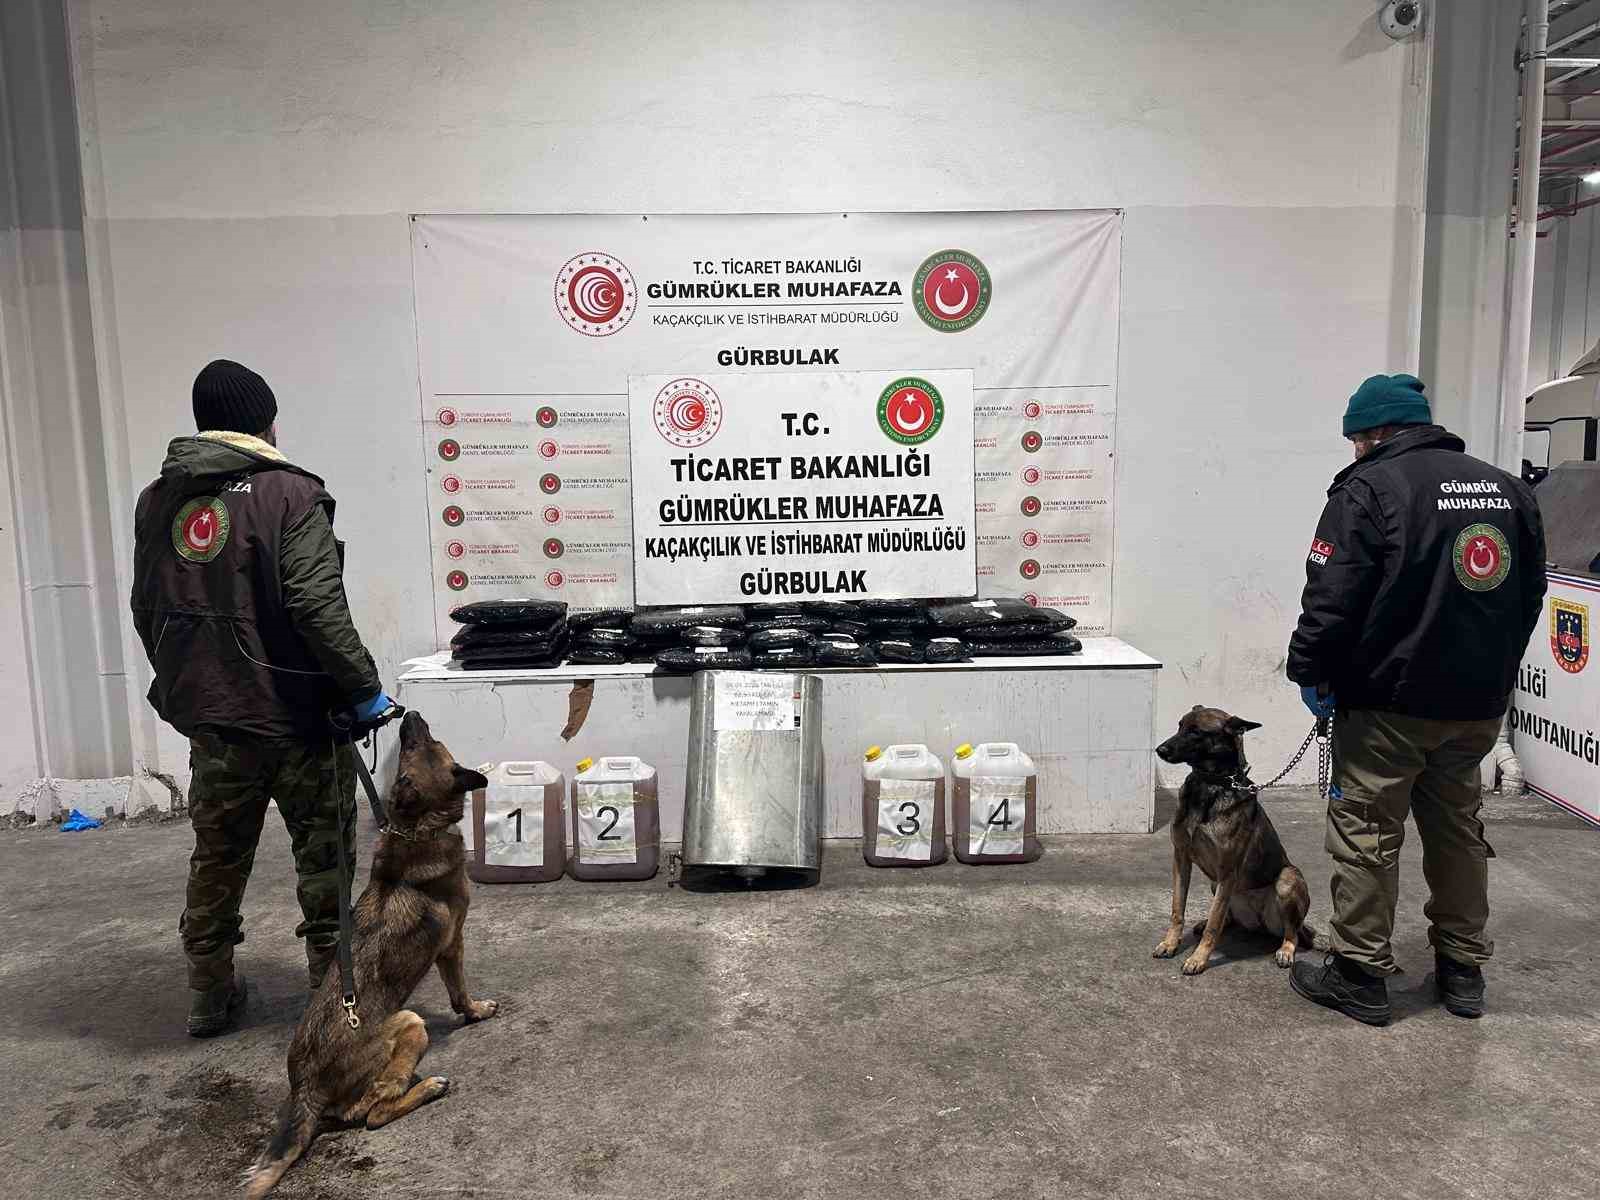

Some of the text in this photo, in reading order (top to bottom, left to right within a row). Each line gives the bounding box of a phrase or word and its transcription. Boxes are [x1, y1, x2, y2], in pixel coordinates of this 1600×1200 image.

[693, 255, 861, 276] T.C. TİCARET BAKANLIĞI
[646, 279, 902, 299] GÜMRÜKLER MUHAFAZA
[652, 310, 899, 328] KAÇAKÇILIK VE İSTİHBARAT MÜDÜRLÜĞÜ
[717, 345, 840, 367] GÜRBULAK
[781, 413, 830, 436] T.C.
[670, 448, 931, 482] TİCARET BAKANLIĞI
[1440, 480, 1501, 494] GÜMRÜK
[659, 493, 944, 523] GÜMRÜKLER MUHAFAZA
[1437, 498, 1512, 511] MUHAFAZA
[645, 526, 966, 563] KAÇAKÇILIK VE İSTİHBARAT MÜDÜRLÜĞÜ
[1310, 551, 1328, 566] KEM
[739, 568, 867, 596] GÜRBULAK
[507, 808, 522, 843] 1
[596, 806, 622, 841] 2
[896, 801, 921, 836] 3
[987, 798, 1013, 832] 4
